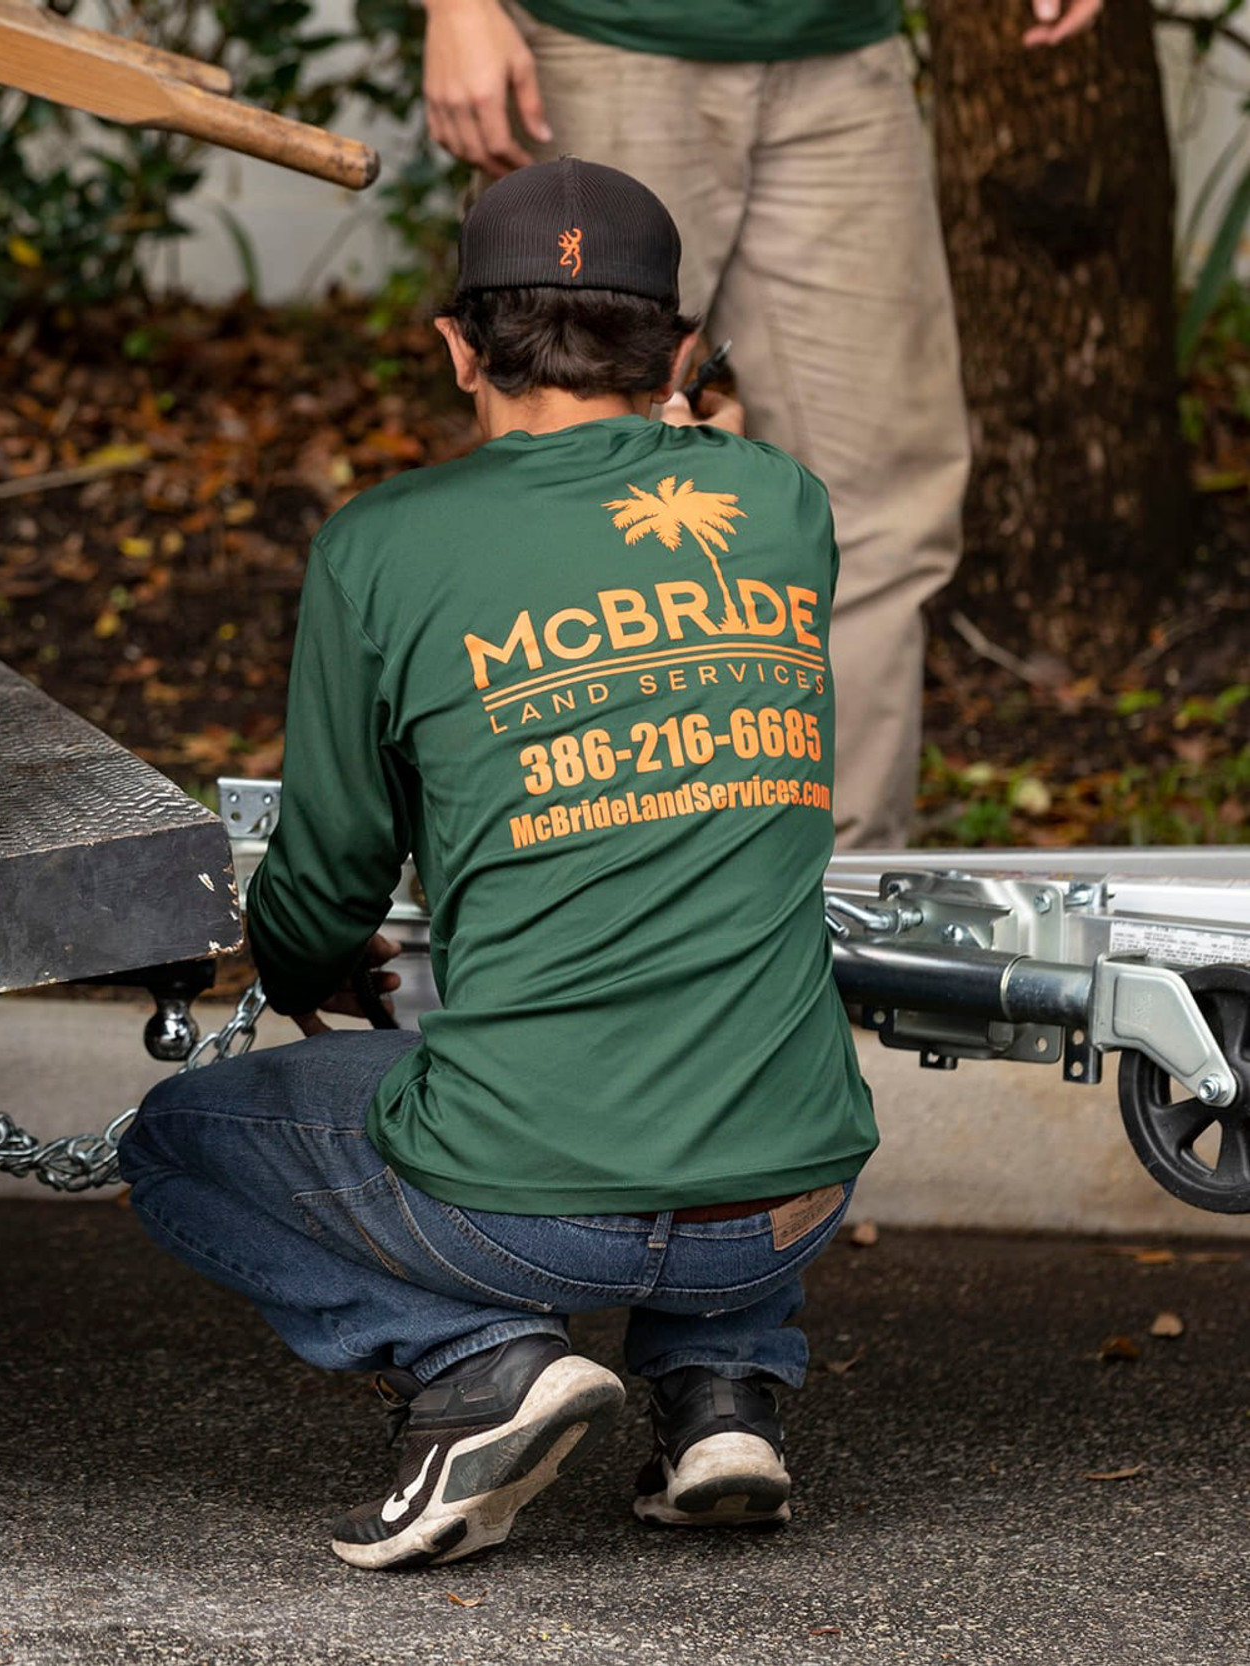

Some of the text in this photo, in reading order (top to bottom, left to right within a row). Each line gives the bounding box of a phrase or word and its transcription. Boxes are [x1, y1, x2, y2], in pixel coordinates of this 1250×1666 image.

[489, 663, 825, 735] LAND SERVICES
[518, 707, 823, 796] 386-216-6685
[509, 774, 831, 850] McBrideLandServices.com
